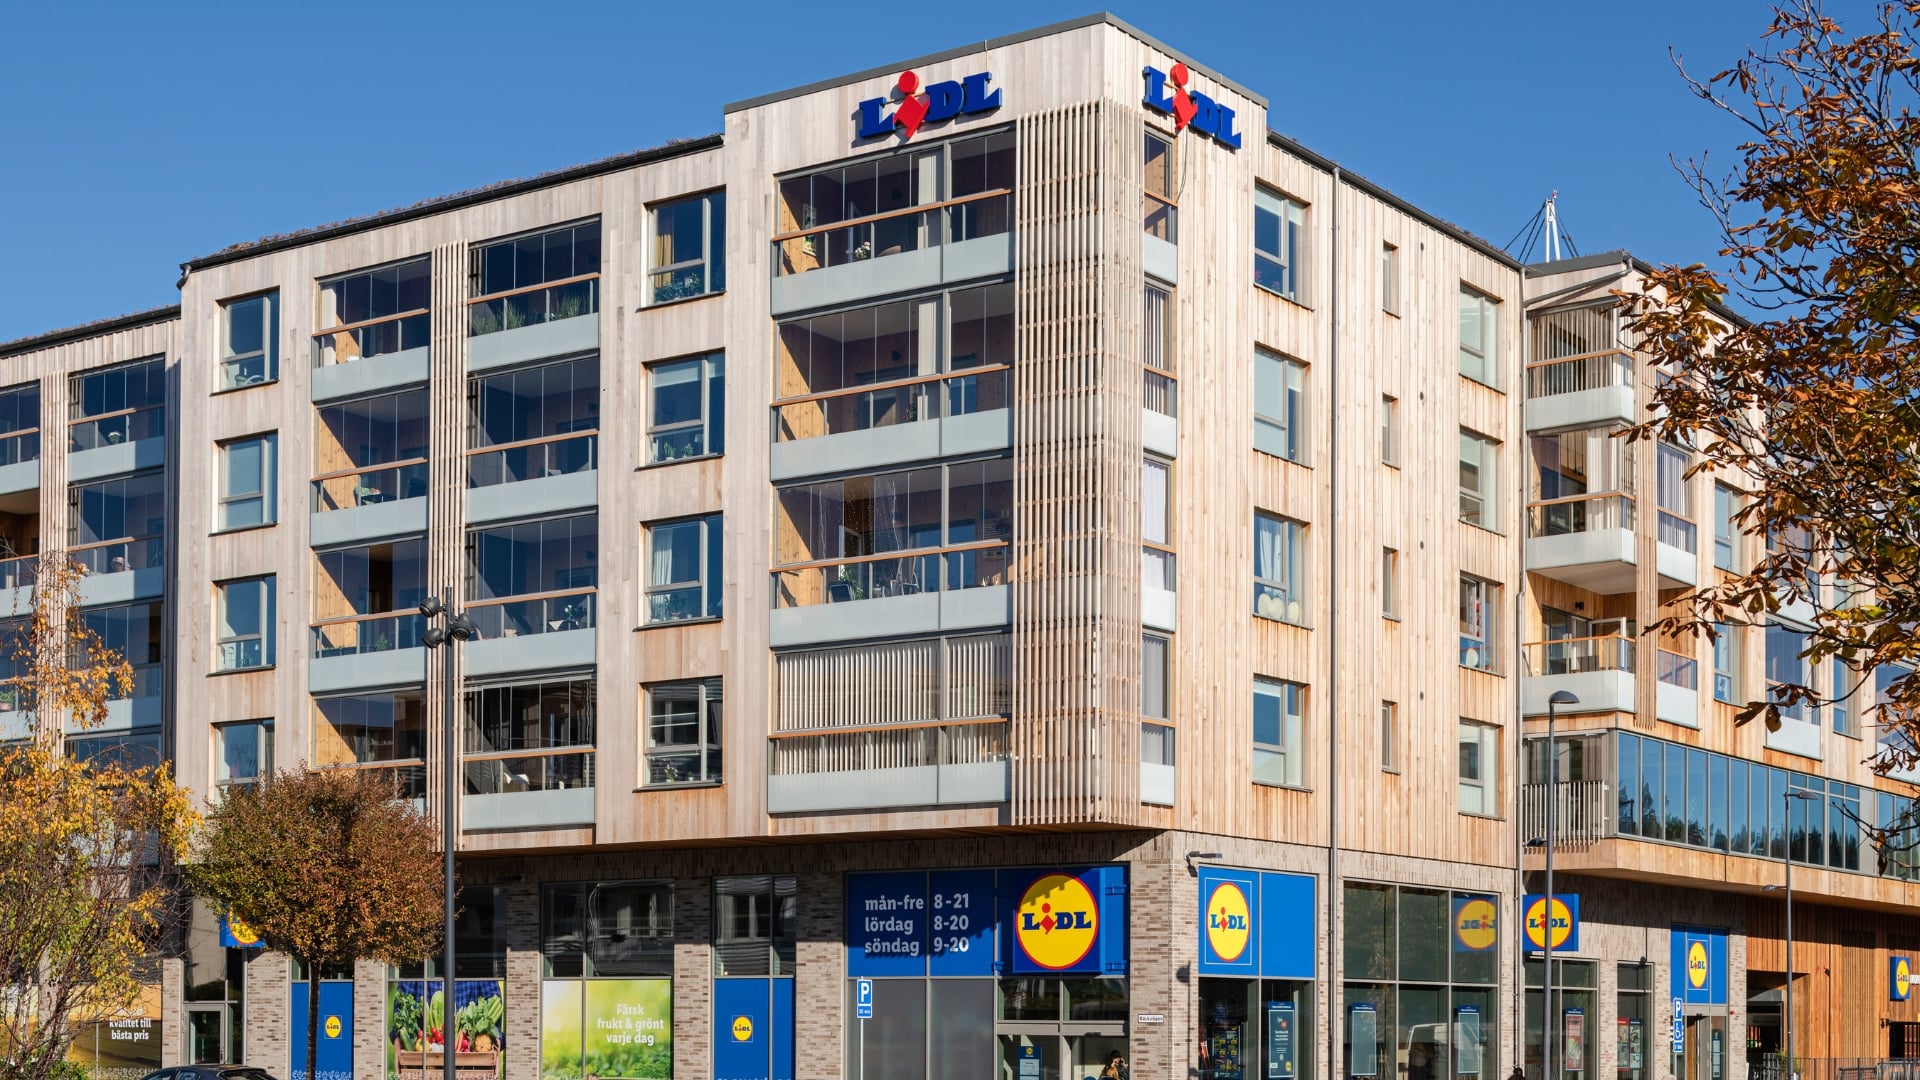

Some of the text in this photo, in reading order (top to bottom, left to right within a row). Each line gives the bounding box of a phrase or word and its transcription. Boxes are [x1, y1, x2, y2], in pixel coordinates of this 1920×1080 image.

[865, 894, 924, 911] mån-fre
[865, 915, 969, 935] lördag 8-20
[865, 937, 970, 957] söndag 9-20
[860, 982, 870, 1003] P
[616, 1003, 645, 1015] Färsk
[1675, 1000, 1681, 1018] P
[109, 1017, 152, 1028] kvalitet till
[597, 1017, 665, 1032] frukt & grönt
[111, 1030, 149, 1042] bästa pris
[606, 1031, 654, 1046] varje dag
